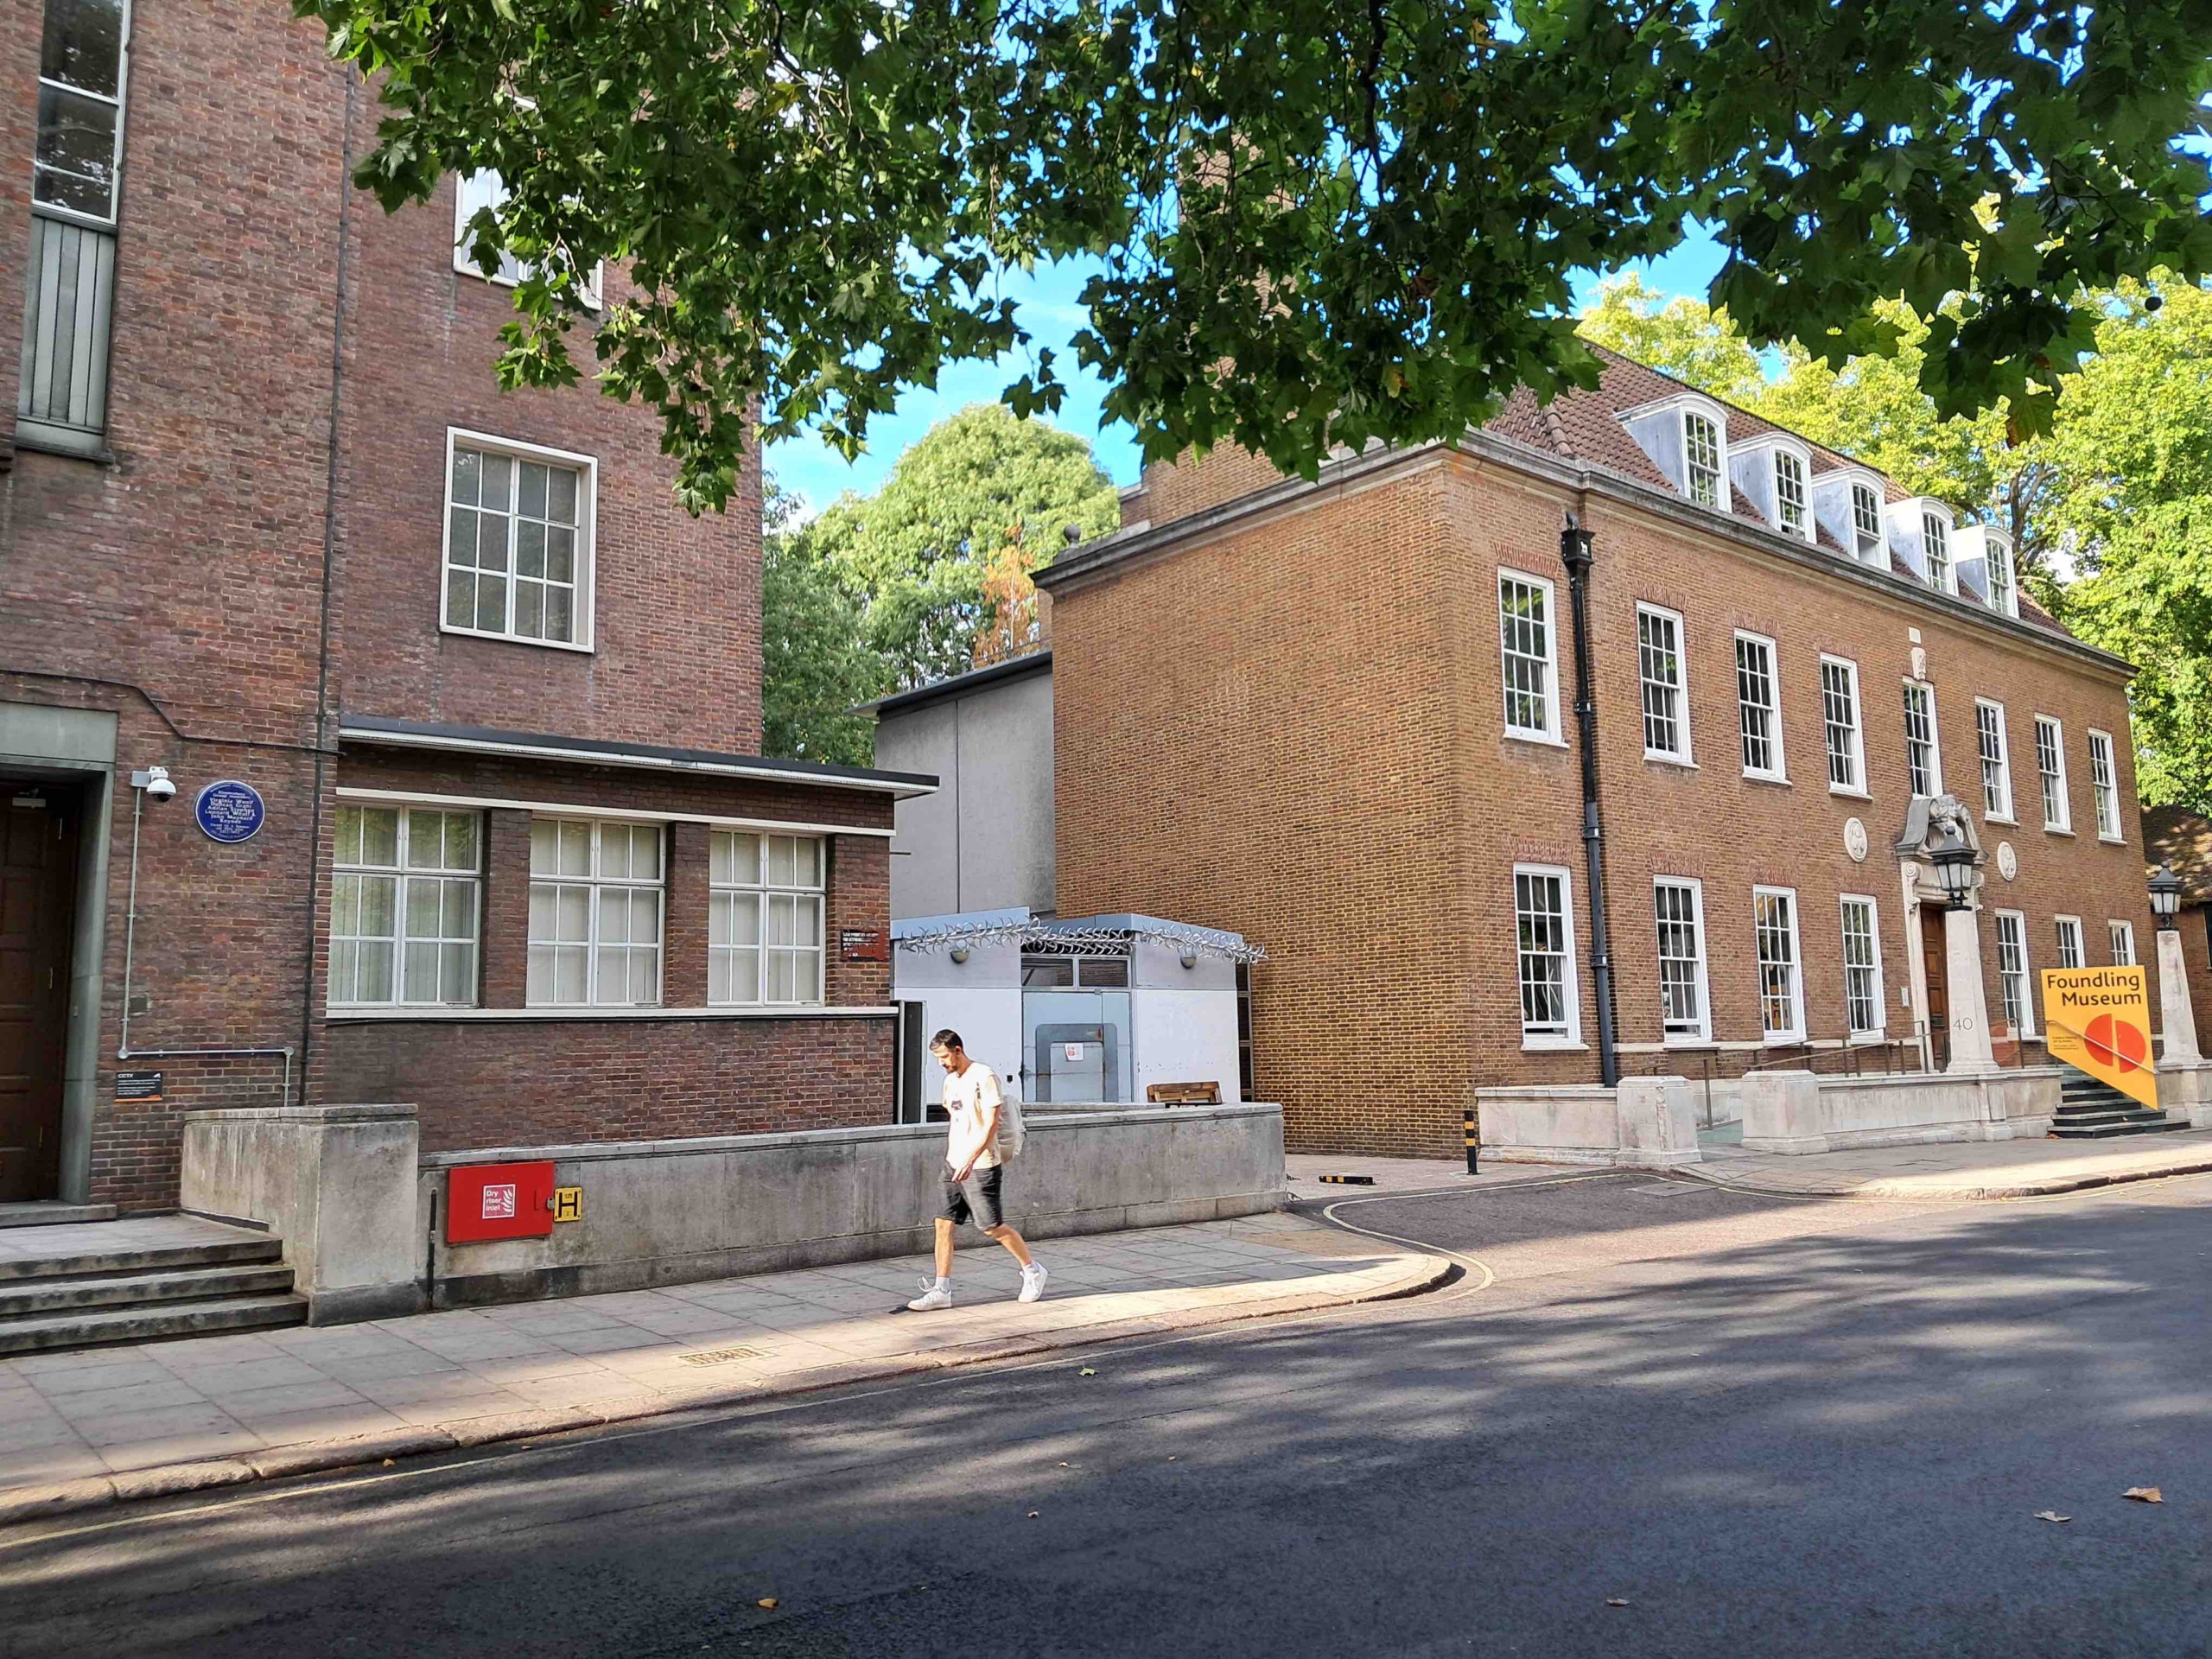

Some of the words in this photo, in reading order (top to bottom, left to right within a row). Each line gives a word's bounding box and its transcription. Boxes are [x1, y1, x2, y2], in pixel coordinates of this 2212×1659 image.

[2047, 971, 2139, 991] Foundling
[2062, 992, 2141, 1007] Museum
[1953, 1017, 1974, 1031] 40
